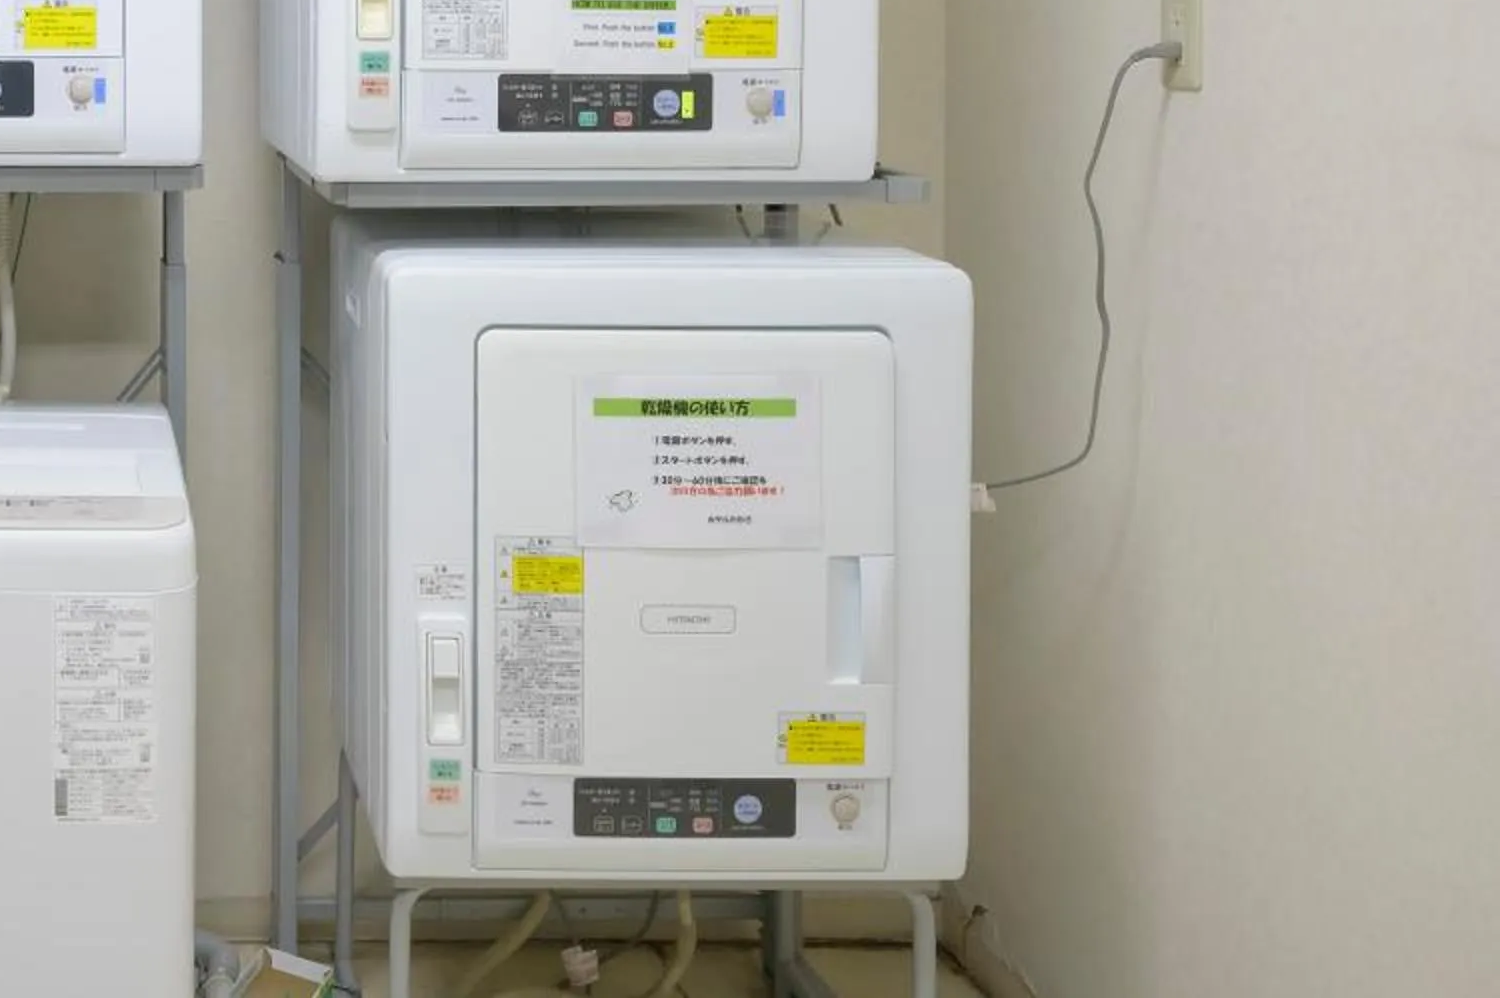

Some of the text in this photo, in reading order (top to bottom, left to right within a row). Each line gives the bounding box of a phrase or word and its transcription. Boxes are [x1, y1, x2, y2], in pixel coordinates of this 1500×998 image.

[641, 399, 750, 417] 乾燥機の使い方
